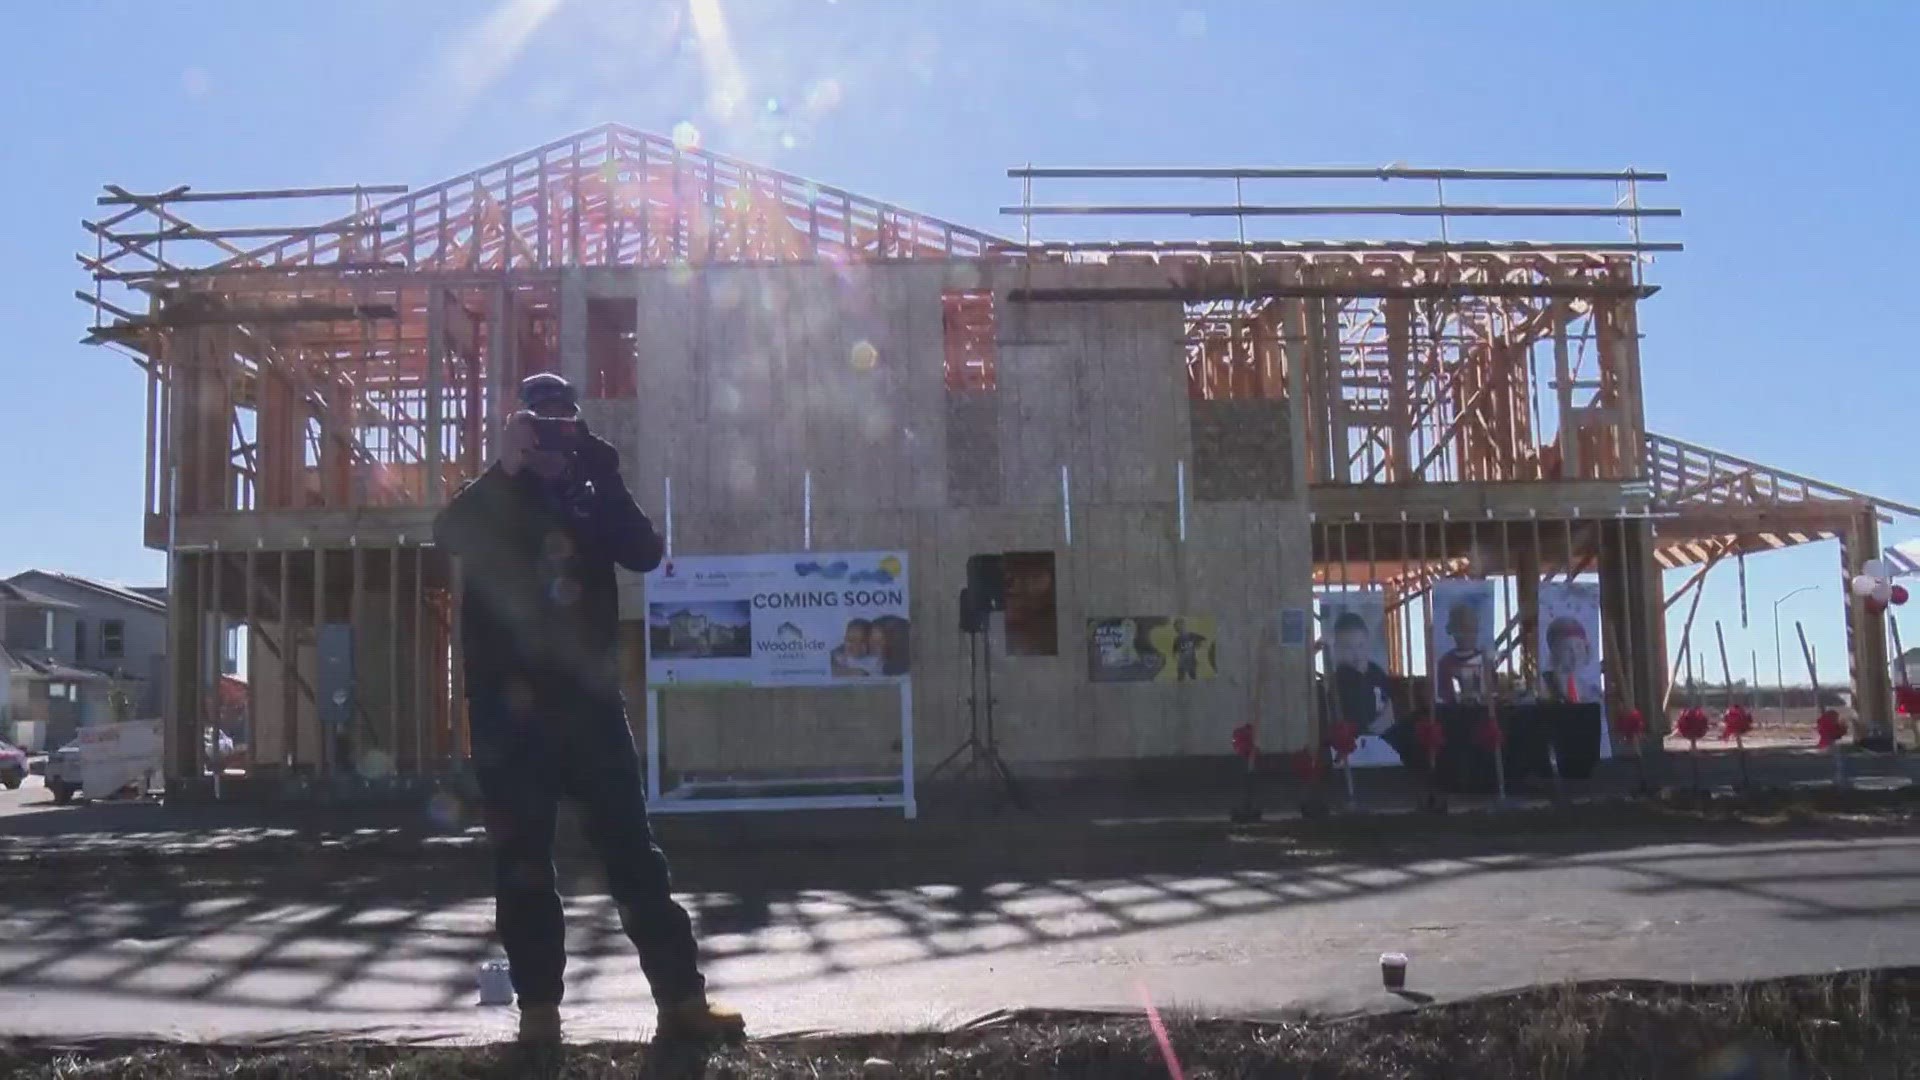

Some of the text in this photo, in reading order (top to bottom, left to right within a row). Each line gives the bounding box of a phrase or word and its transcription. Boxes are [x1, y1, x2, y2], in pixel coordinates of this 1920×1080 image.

[752, 589, 903, 609] COMING SOON
[756, 638, 826, 652] Woodside
